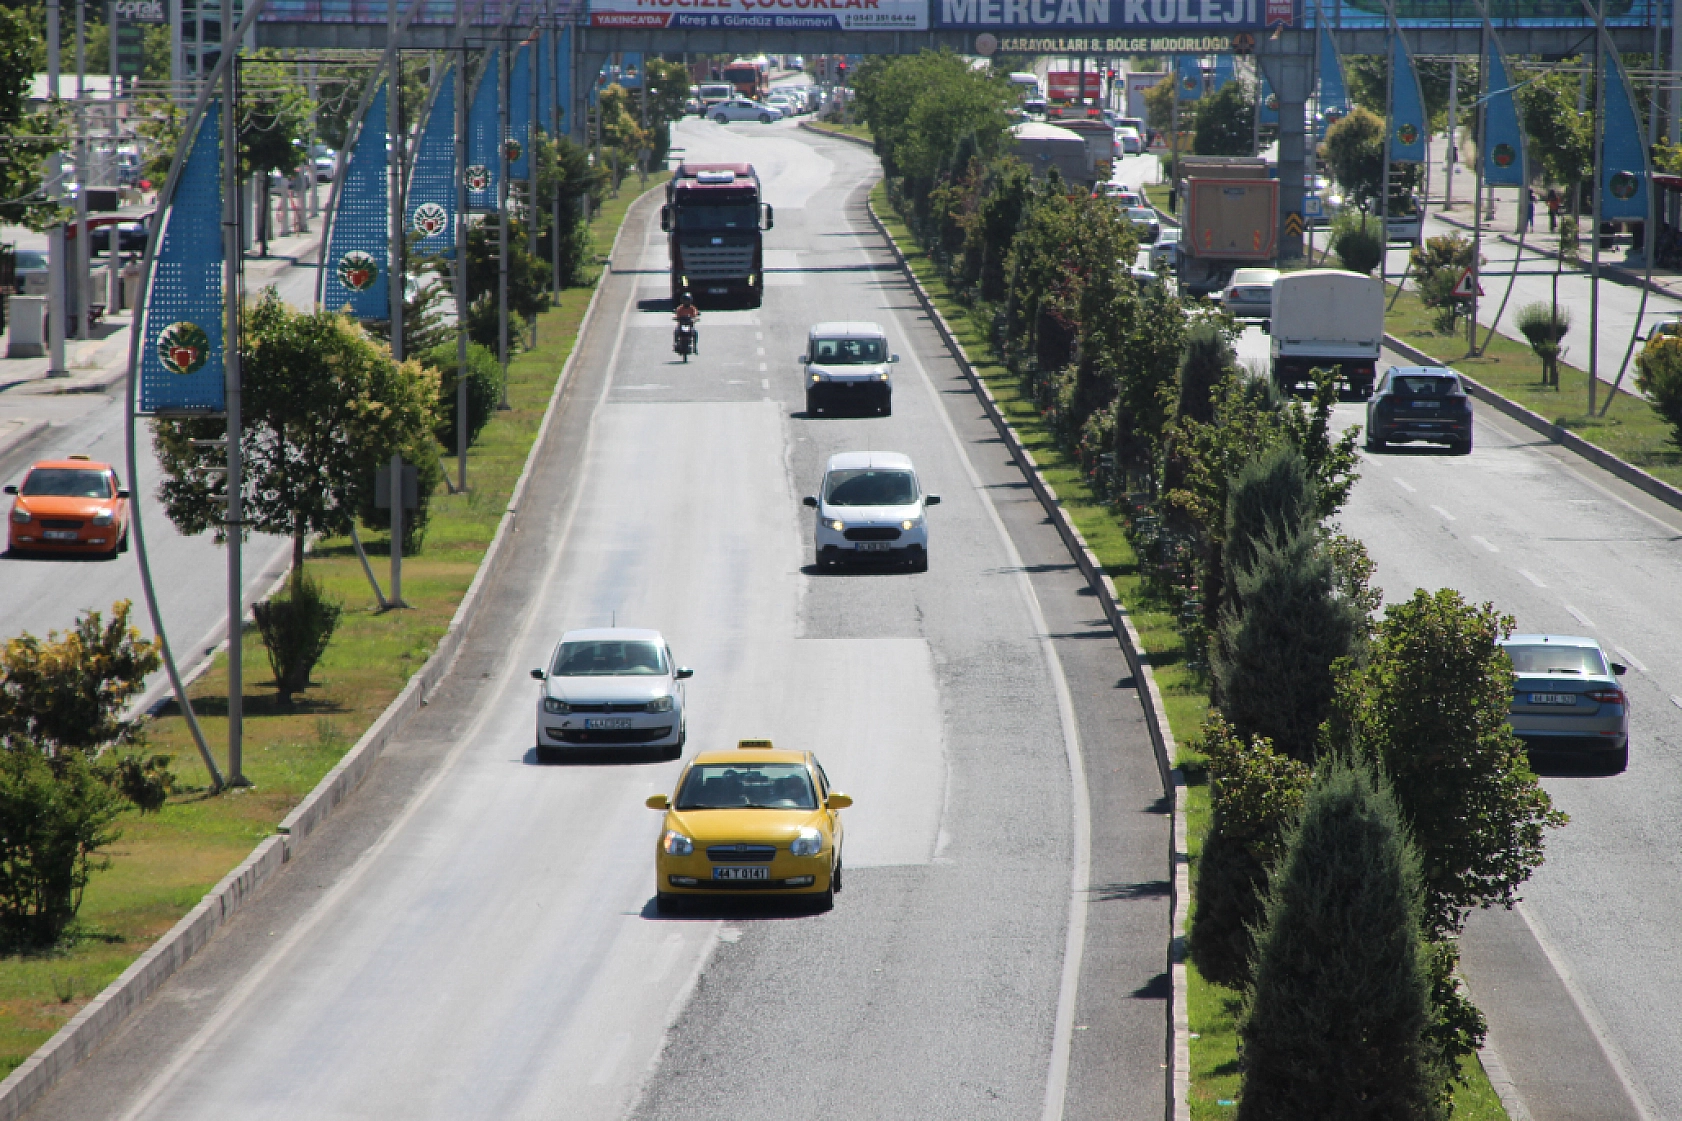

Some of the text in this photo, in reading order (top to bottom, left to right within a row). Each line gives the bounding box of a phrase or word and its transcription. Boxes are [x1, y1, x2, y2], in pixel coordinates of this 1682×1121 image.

[942, 0, 1109, 24] MERCAN
[710, 14, 720, 25] &
[723, 14, 771, 26] Gündüz
[1001, 38, 1088, 52] KARAYOLLARI
[718, 868, 764, 880] 44 T 0141
